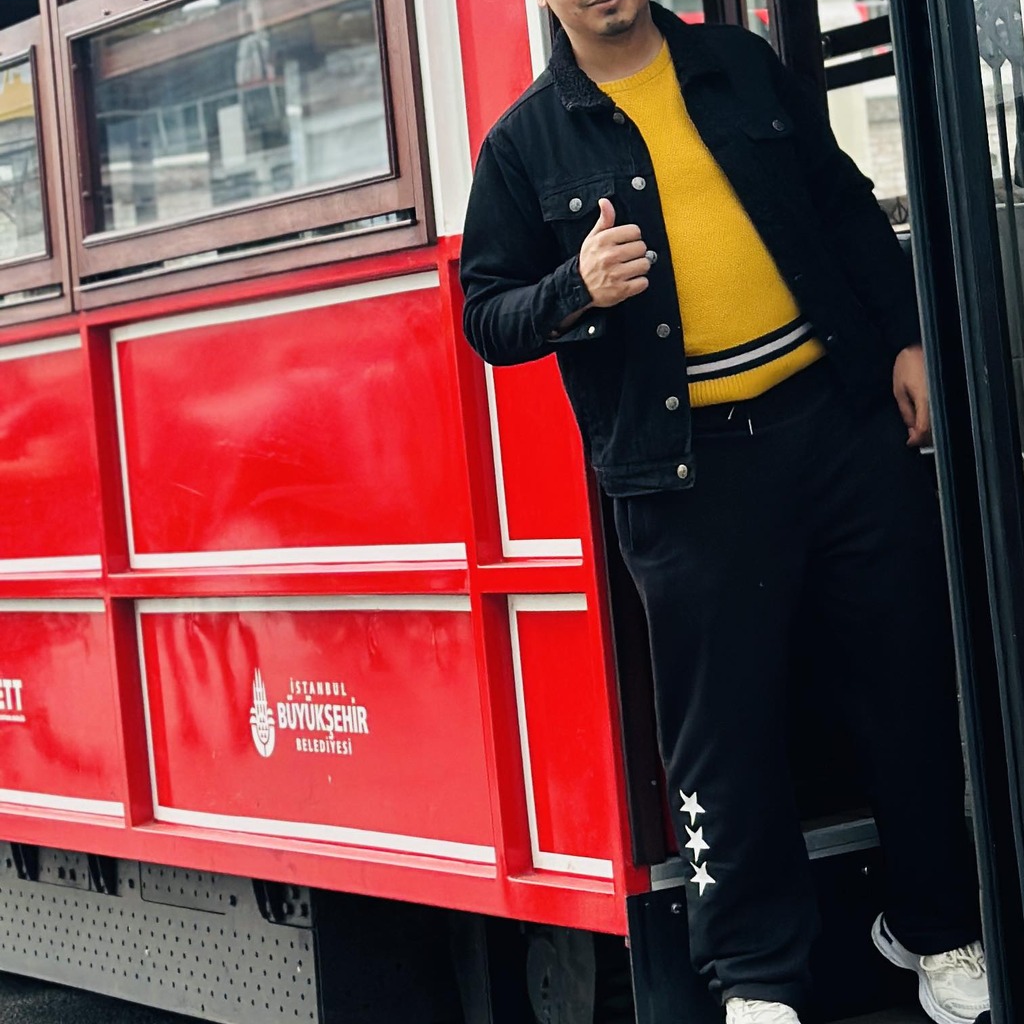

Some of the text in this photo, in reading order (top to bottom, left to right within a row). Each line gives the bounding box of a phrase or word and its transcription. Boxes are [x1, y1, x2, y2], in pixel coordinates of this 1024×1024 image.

[290, 677, 347, 696] İSTANBUL
[277, 694, 369, 739] BÜYÜKŞEHİR
[296, 737, 352, 755] BELEDİYESİ
